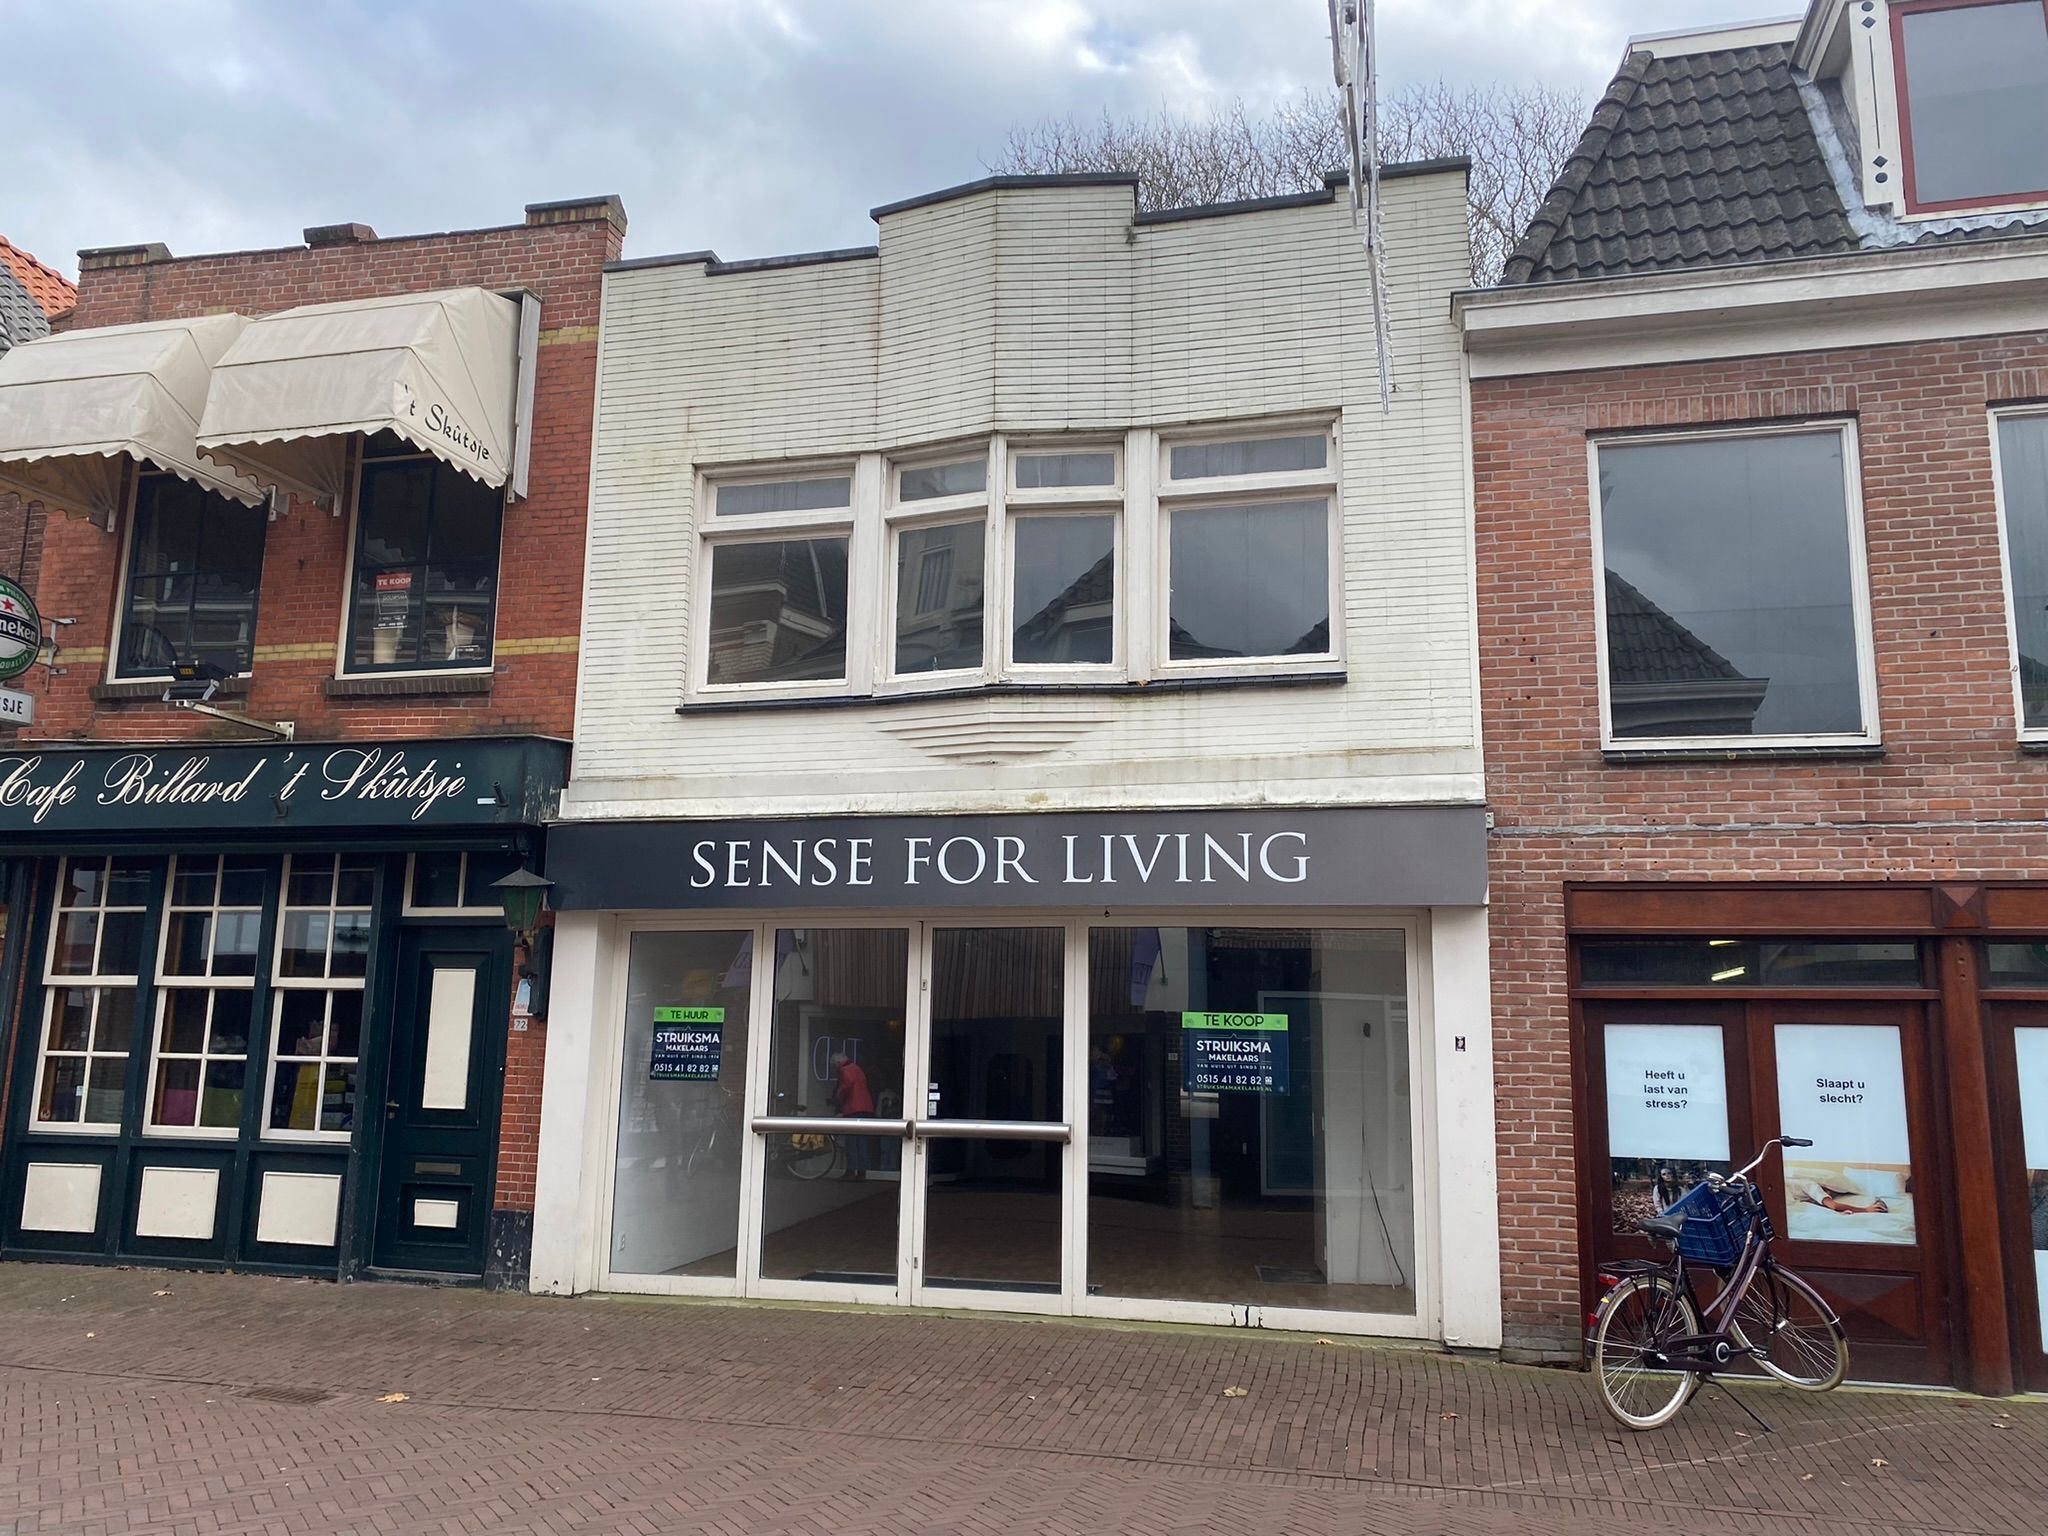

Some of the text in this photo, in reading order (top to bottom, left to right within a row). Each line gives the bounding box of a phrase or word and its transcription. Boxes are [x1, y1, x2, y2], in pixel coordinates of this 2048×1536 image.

[404, 384, 490, 462] 't Skûtsje
[377, 577, 411, 586] TE KOOP
[0, 696, 23, 715] SJE
[0, 747, 466, 824] Cafe Billard 't Skûtsje
[690, 831, 1311, 889] SENSE FOR LIVING
[671, 1010, 708, 1019] TE HUUR
[515, 1020, 527, 1030] 72
[1203, 1014, 1265, 1027] TE KOOP
[656, 1032, 720, 1044] STRUIKSMA
[665, 1044, 709, 1052] MAKELAARS
[1196, 1040, 1272, 1053] STRUIKSMA
[1208, 1053, 1259, 1062] MAKELAARS
[654, 1063, 672, 1072] 0515
[675, 1063, 684, 1072] 41
[687, 1063, 698, 1073] 82
[699, 1064, 710, 1073] 82
[1196, 1074, 1262, 1085] 0515 41 82 82
[1645, 1070, 1675, 1079] Heeft
[1644, 1085, 1688, 1095] last van
[1816, 1078, 1865, 1091] Slaapt u
[1645, 1099, 1688, 1109] stress?
[1819, 1093, 1864, 1104] slecht?
